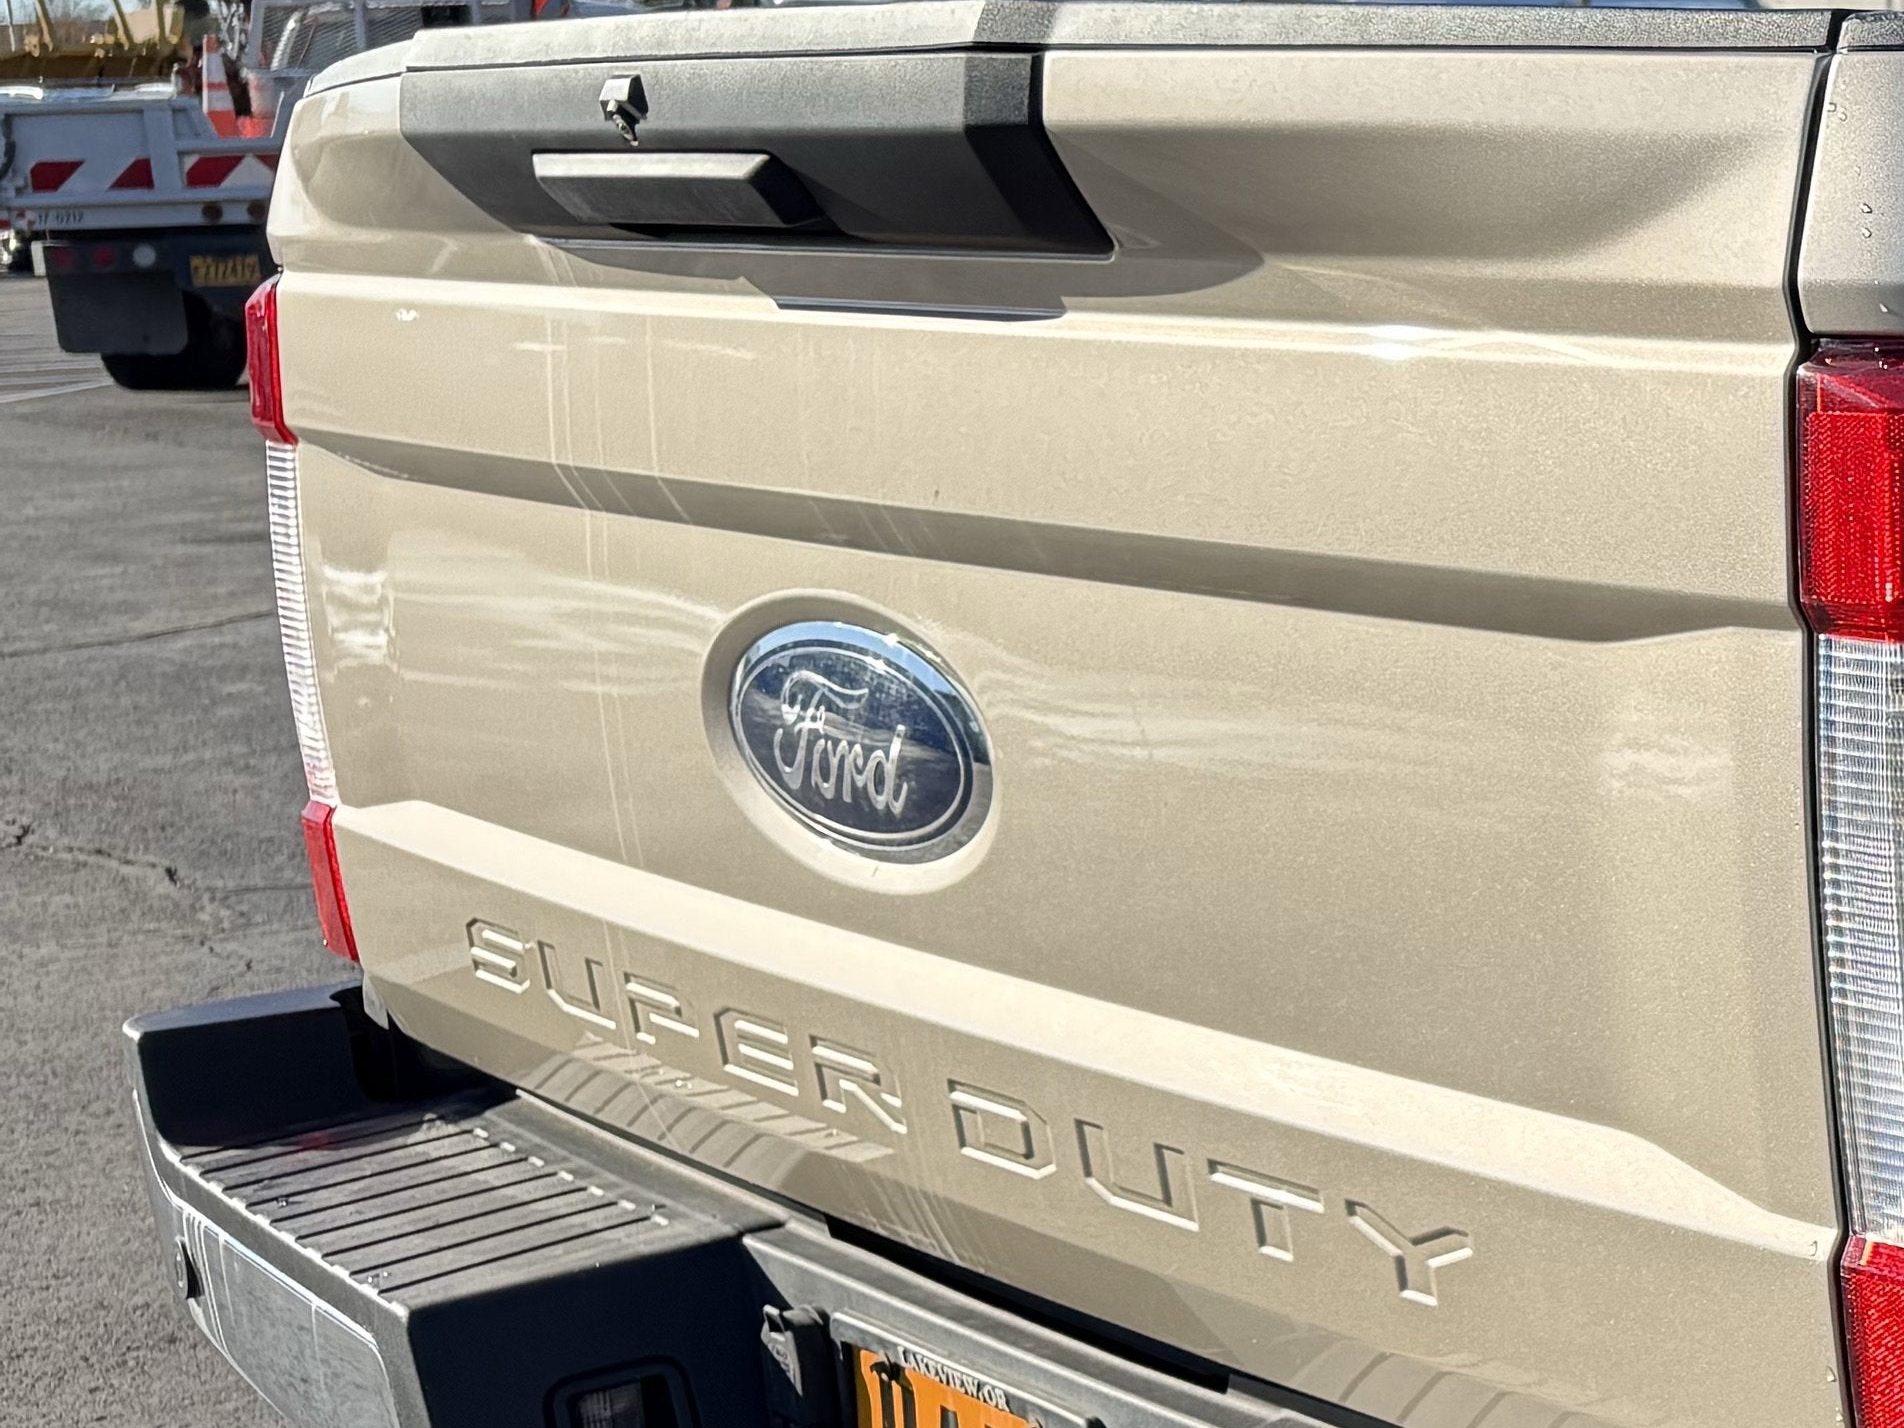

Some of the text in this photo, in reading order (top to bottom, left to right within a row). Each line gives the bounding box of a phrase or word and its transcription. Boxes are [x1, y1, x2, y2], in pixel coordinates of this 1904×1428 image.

[772, 670, 909, 815] Ford
[465, 917, 1473, 1306] SUPER DUTY
